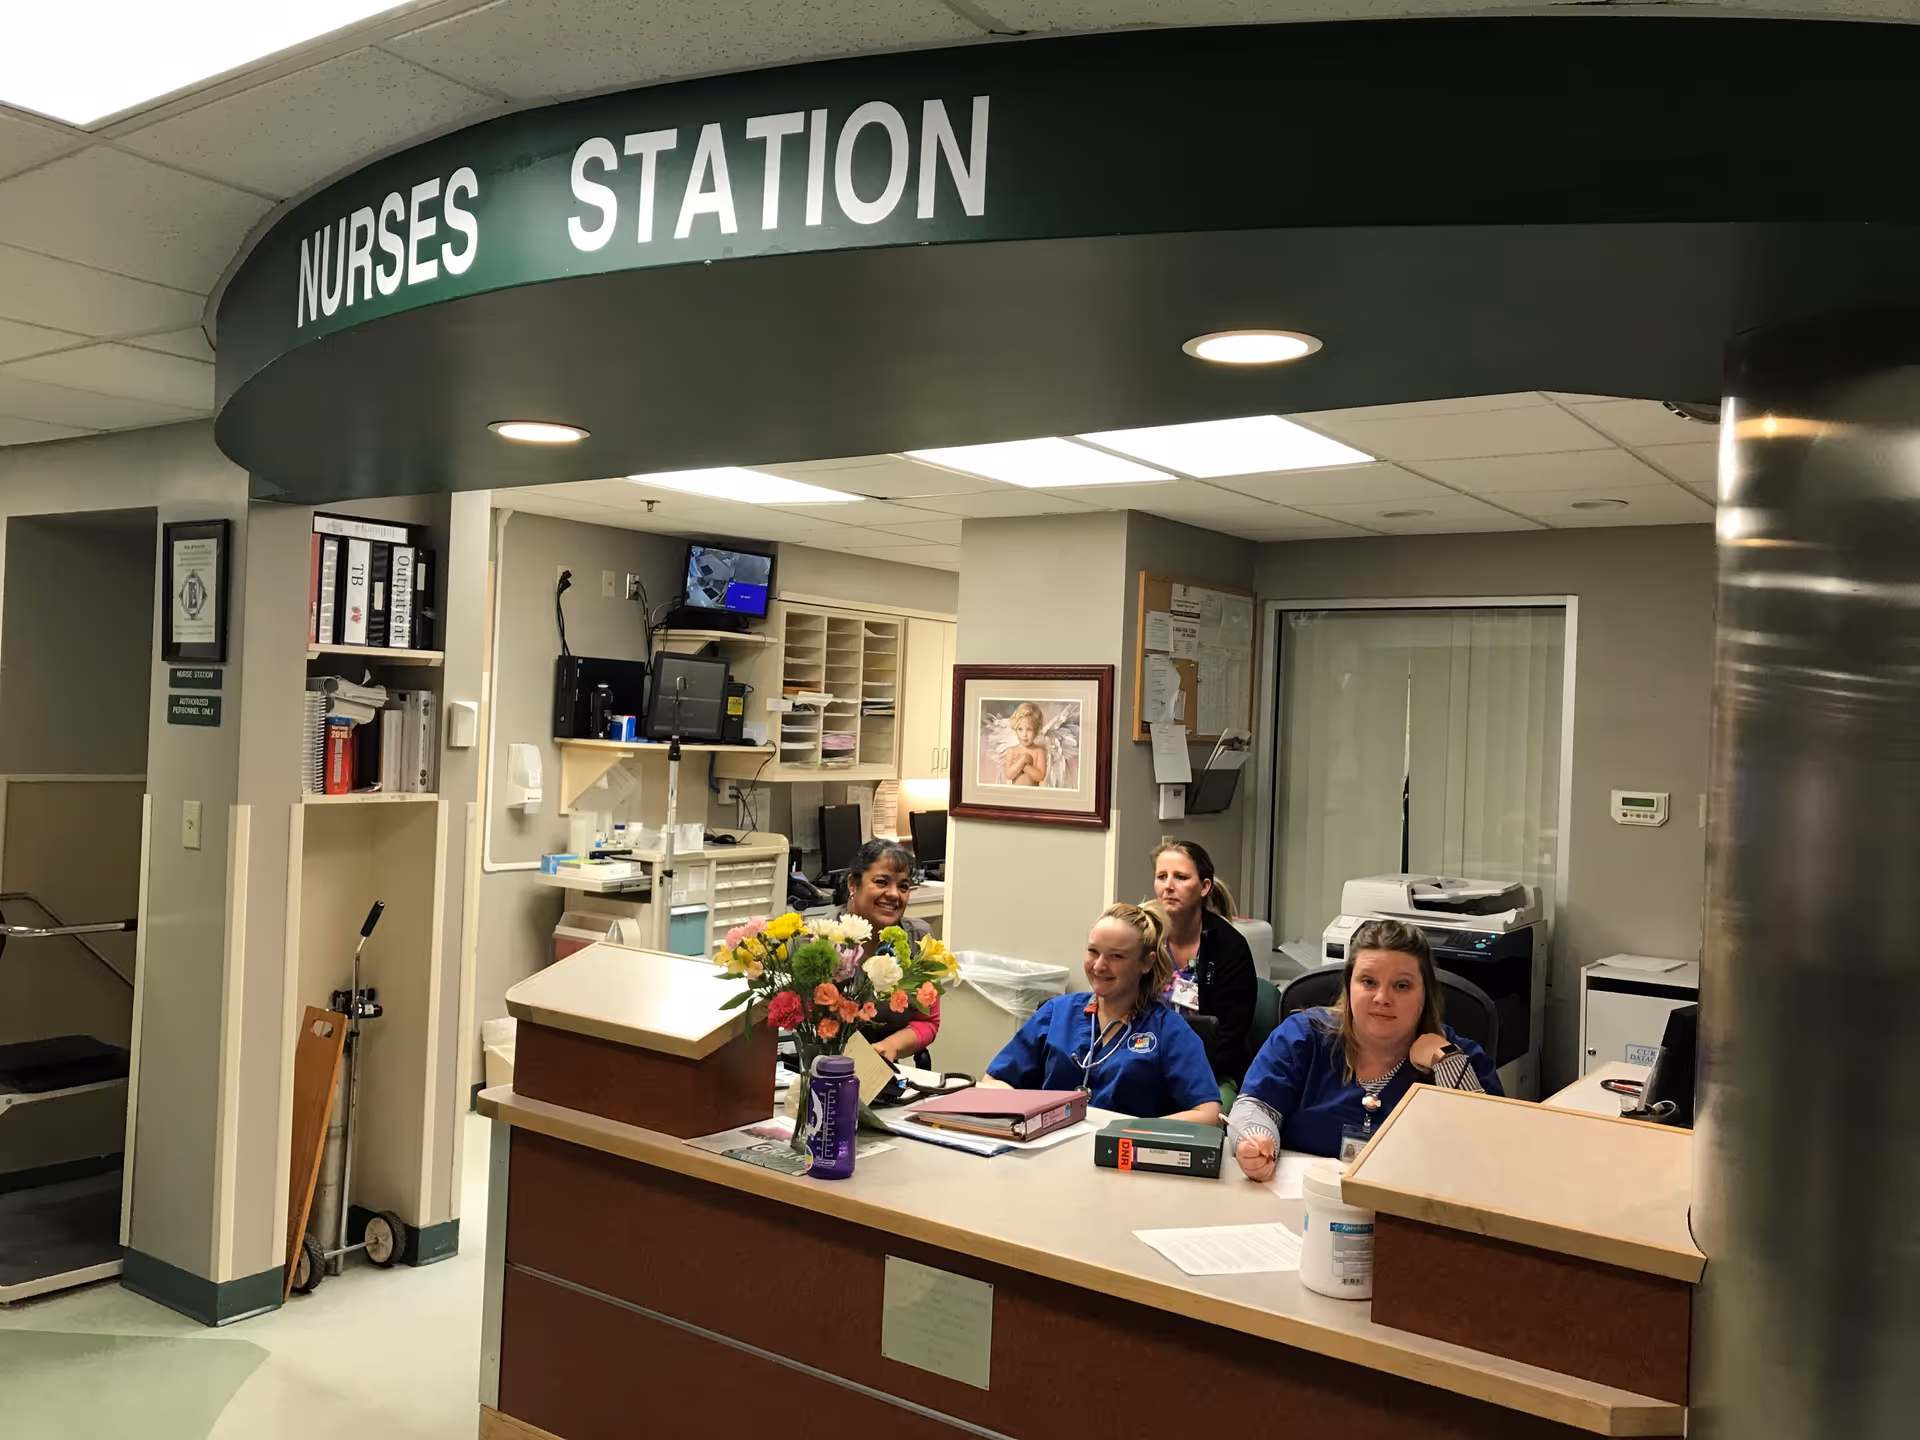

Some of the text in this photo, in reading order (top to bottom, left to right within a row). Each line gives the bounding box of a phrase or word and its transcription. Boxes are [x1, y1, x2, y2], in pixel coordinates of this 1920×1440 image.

[297, 95, 990, 329] NURSES STATION
[351, 564, 364, 586] TB
[394, 555, 410, 641] Outpatient
[172, 706, 200, 714] PERSONNEL
[1121, 1141, 1130, 1166] DNR
